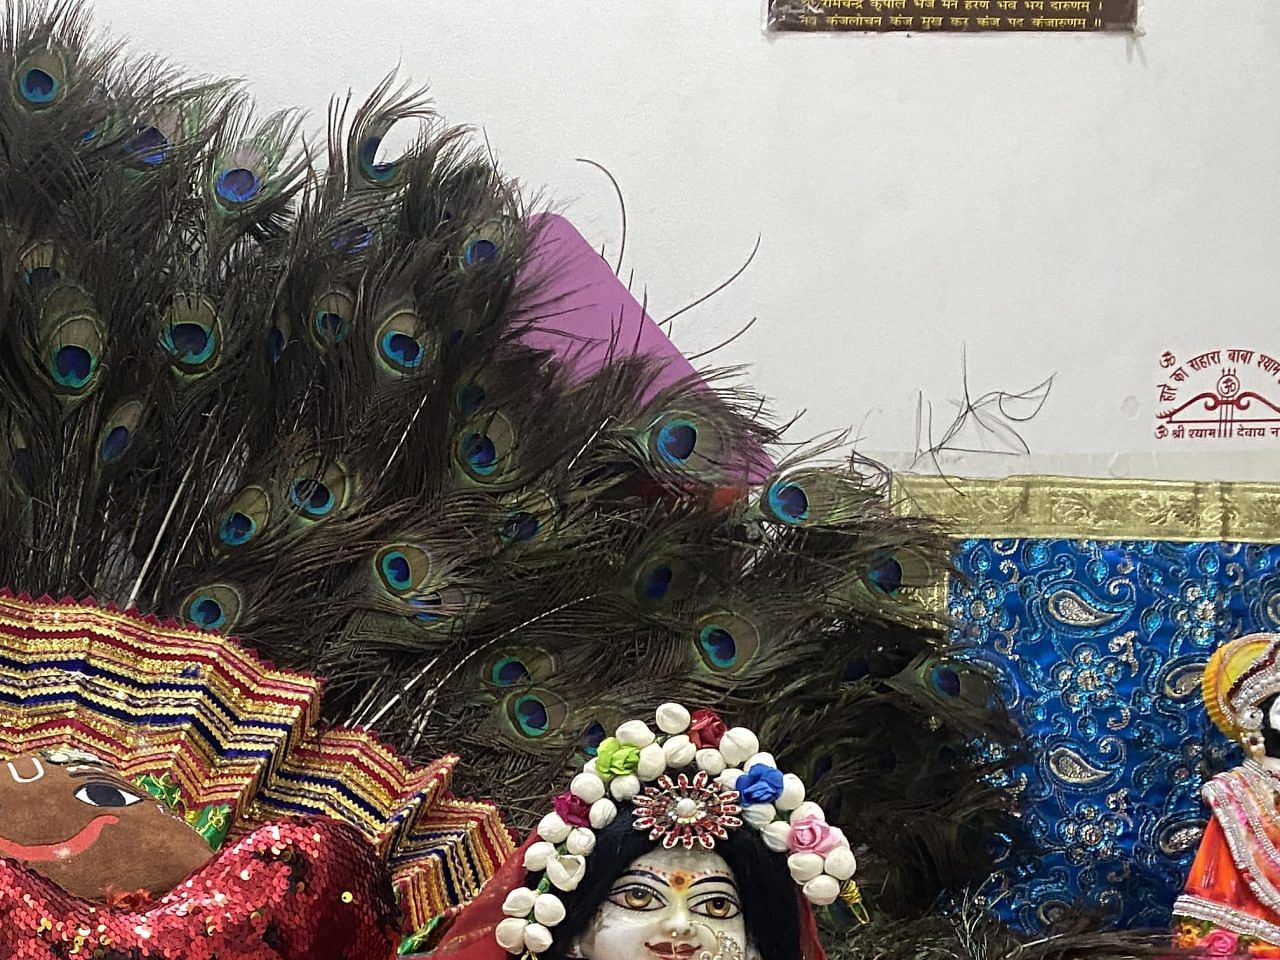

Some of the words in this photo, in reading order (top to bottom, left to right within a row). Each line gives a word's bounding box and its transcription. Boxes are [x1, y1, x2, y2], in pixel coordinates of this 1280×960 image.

[1186, 350, 1221, 372] सहारा
[1227, 349, 1255, 364] बाबा
[1172, 425, 1184, 438] श्री
[1189, 428, 1216, 438] श्याम
[1237, 424, 1265, 438] देवाय
